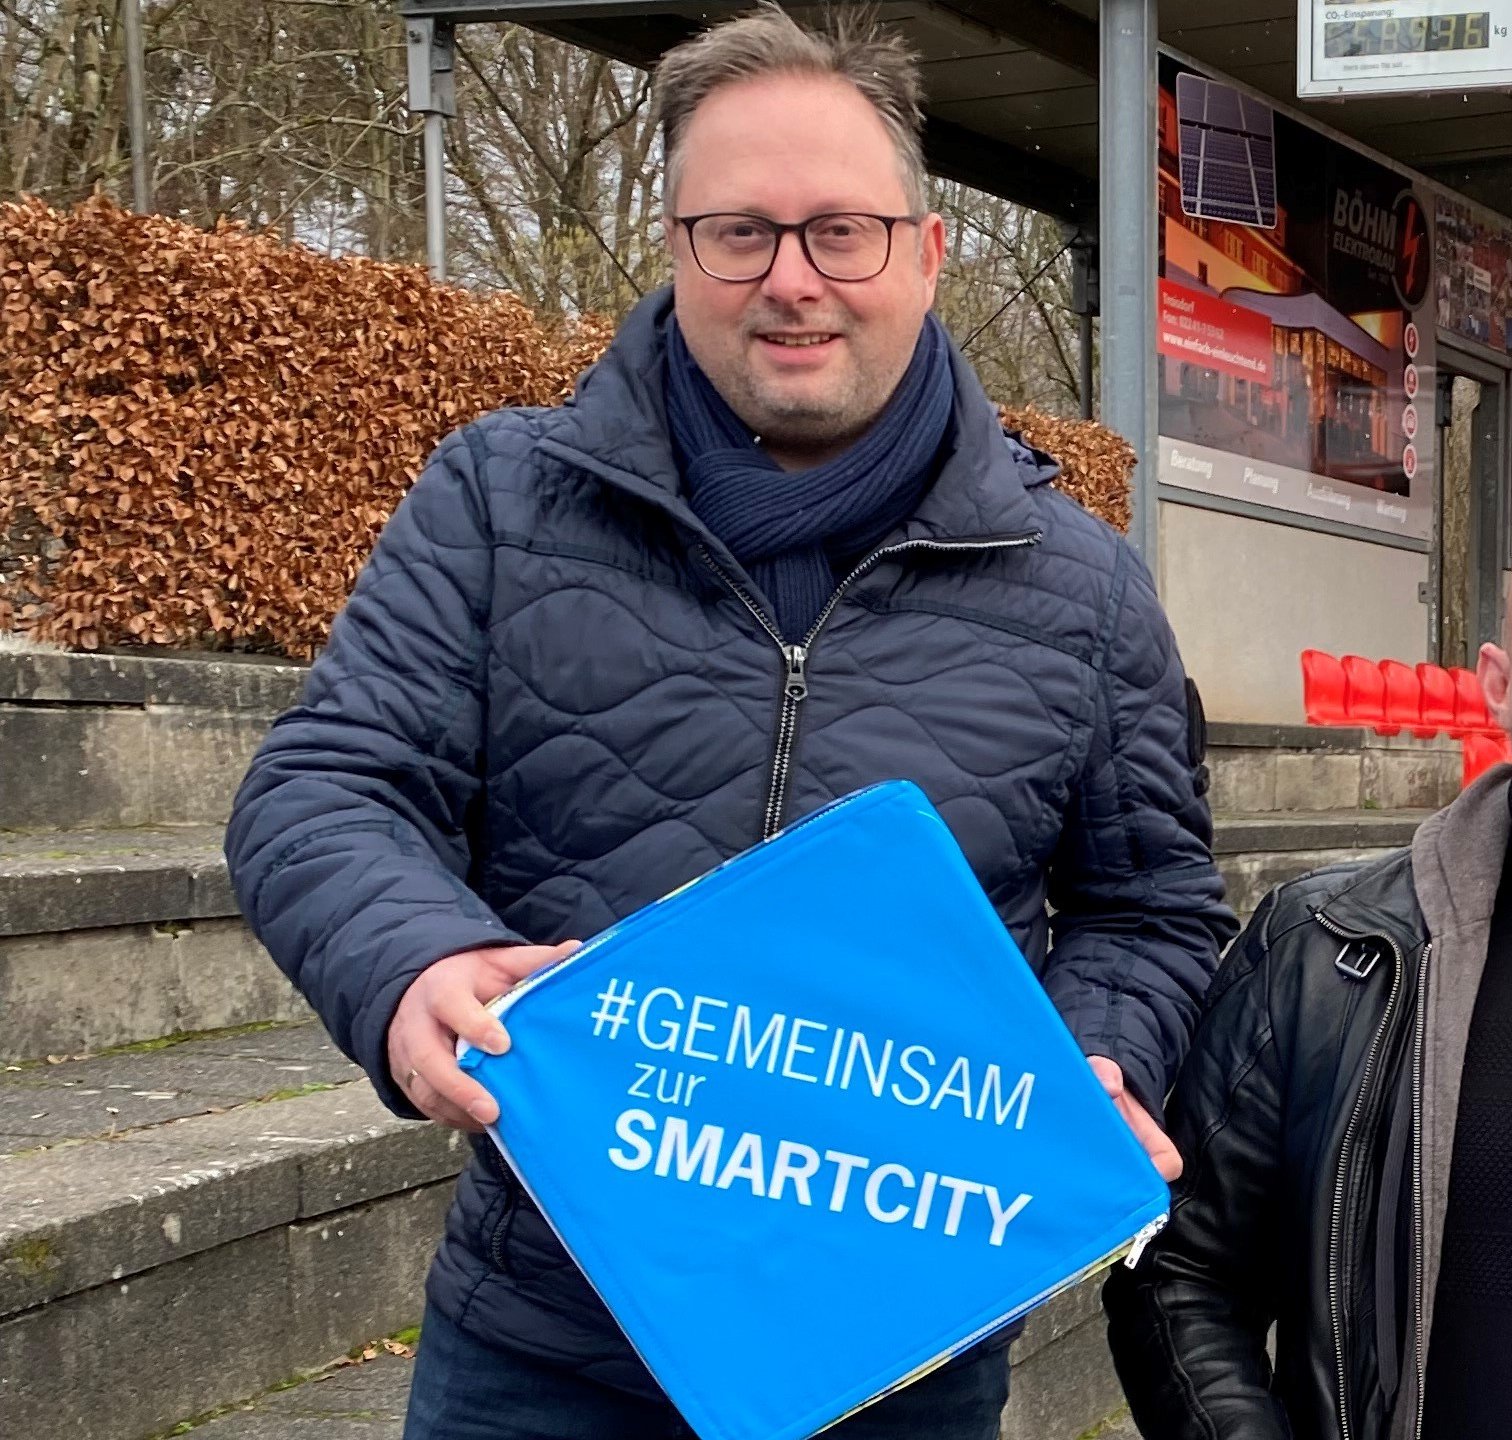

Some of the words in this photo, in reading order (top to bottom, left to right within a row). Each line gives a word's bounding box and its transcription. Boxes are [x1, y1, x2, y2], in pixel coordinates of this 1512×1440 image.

[1493, 25, 1508, 37] kg
[1333, 188, 1397, 251] BÖHM
[1170, 448, 1213, 479] Beratung
[1243, 466, 1279, 495] Planung
[590, 977, 1036, 1130] #GEMEINSAM
[626, 1062, 706, 1108] zur
[607, 1108, 1034, 1247] SMARTCITY
